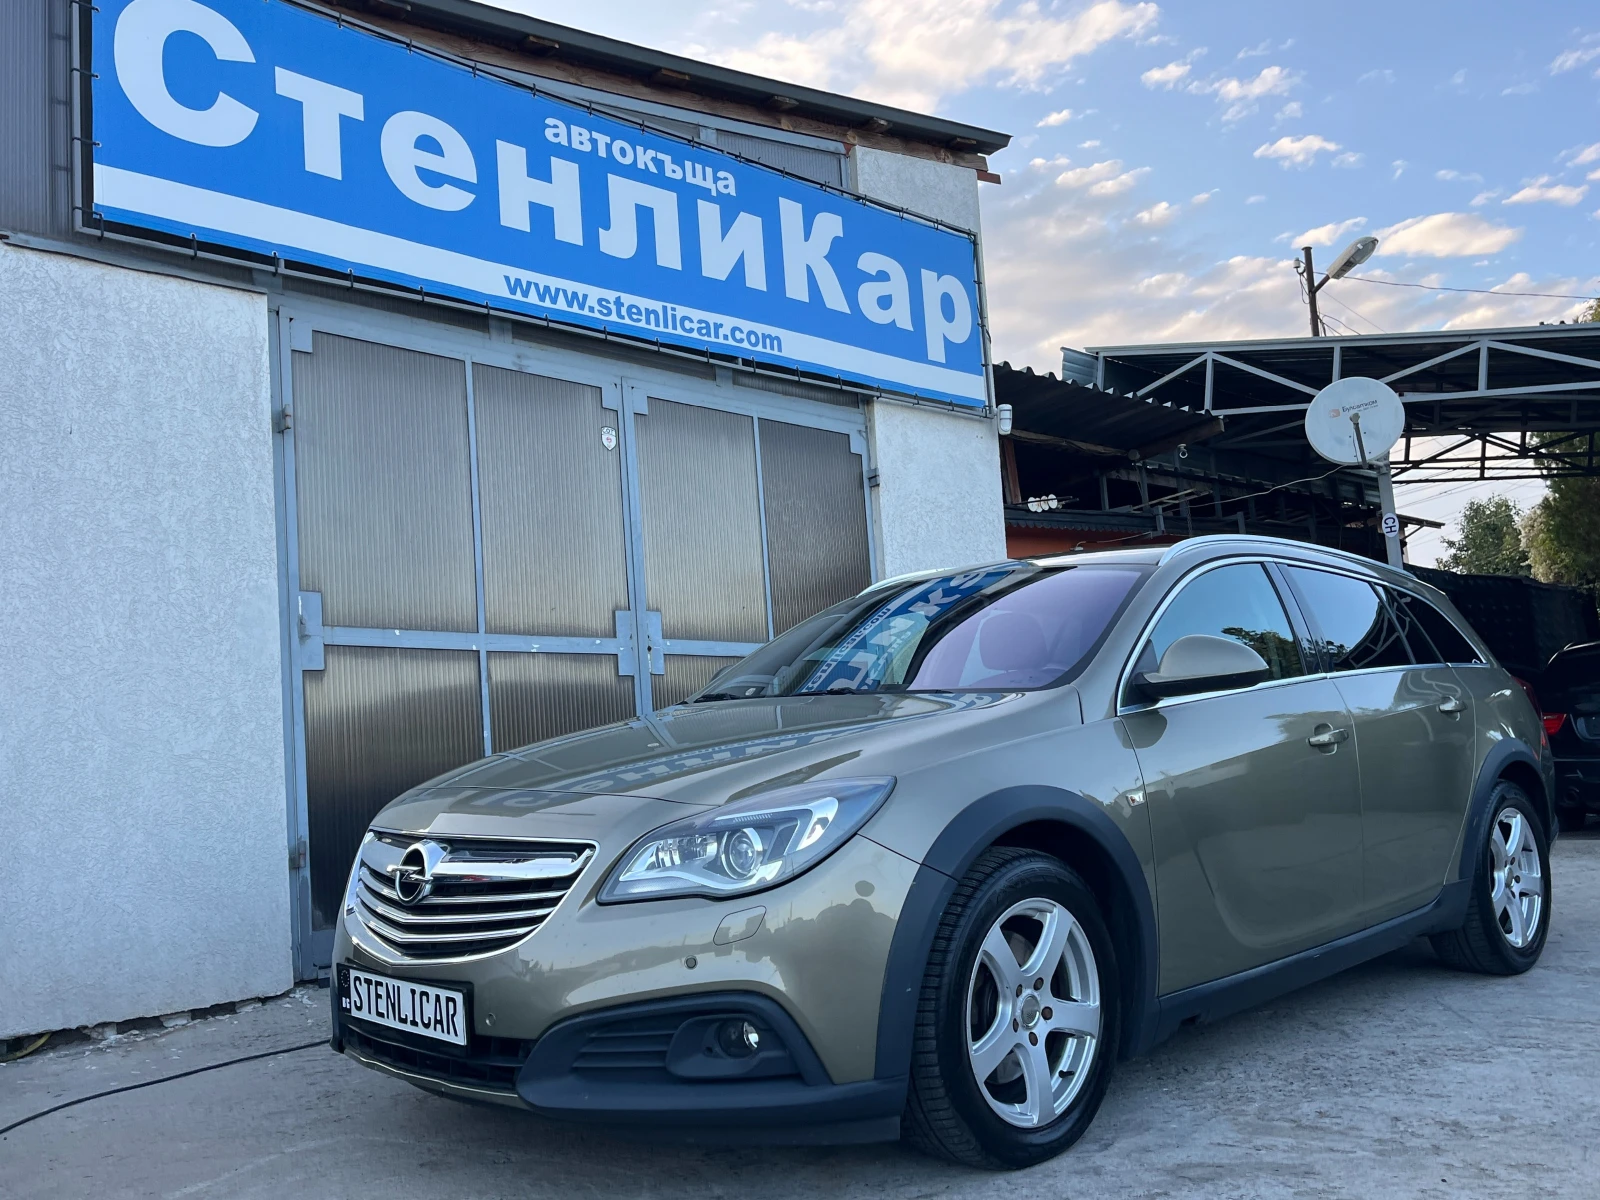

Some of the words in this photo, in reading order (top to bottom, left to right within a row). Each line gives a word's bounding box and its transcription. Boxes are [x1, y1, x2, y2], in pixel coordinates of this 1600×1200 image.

[114, 0, 972, 364] СтенлиКар
[544, 117, 737, 197] автокъща
[504, 275, 783, 354] www.stenlicar.com
[1384, 516, 1397, 534] CH
[353, 975, 459, 1038] STENLICAR
